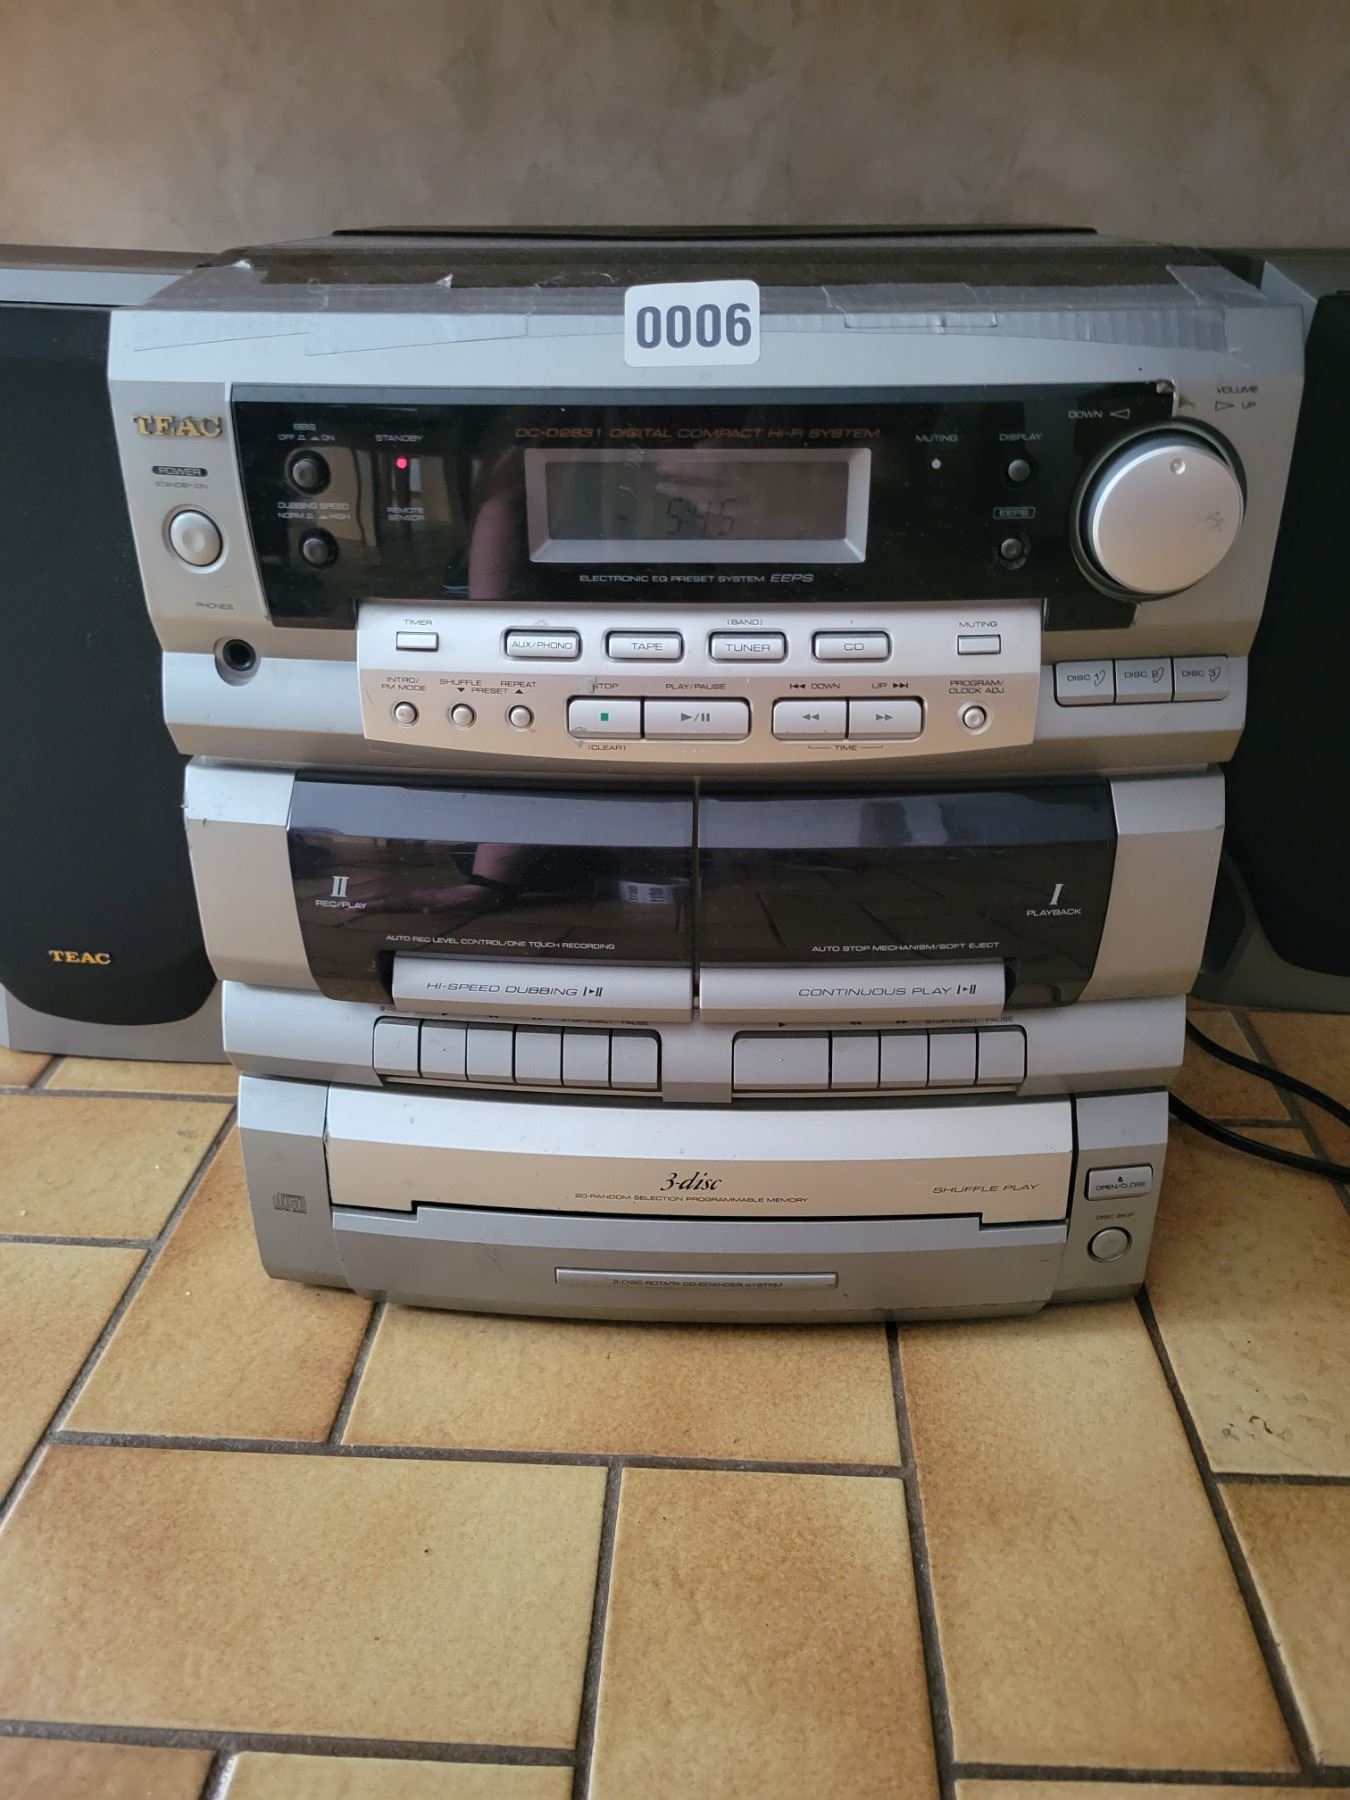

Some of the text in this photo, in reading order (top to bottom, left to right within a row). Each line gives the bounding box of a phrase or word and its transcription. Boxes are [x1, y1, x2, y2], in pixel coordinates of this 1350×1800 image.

[636, 303, 752, 349] 0006
[1216, 385, 1259, 394] VOLUME
[1241, 401, 1257, 410] UP
[1068, 410, 1103, 419] DOWN
[133, 416, 223, 438] TEAC
[609, 427, 673, 438] DIGITAL
[678, 428, 762, 439] COMPACT
[808, 428, 881, 439] SYSTEM
[999, 432, 1043, 442] DISPLAY
[375, 434, 425, 442] STANDBY
[915, 433, 959, 443] MUTING
[158, 466, 201, 477] POWER
[277, 502, 350, 510] DUBBING SPEED
[386, 507, 425, 515] REMOTE
[387, 514, 425, 522] SENSOR
[579, 573, 814, 583] ELECTRONIC EQ PRESET SYSTEM EEPS
[196, 601, 234, 611] PHONES
[404, 618, 433, 626] TIMER
[958, 620, 998, 628] MUTING
[511, 641, 573, 651] AUX/PHONO
[631, 642, 664, 651] TAPE
[726, 643, 771, 652] TUNER
[843, 642, 865, 651] CD
[1066, 673, 1092, 682] DISC
[1123, 670, 1149, 679] DISC
[1181, 669, 1206, 678] DISC
[386, 676, 420, 684] INTRO/
[439, 678, 483, 687] SHUFFLE
[500, 680, 537, 688] REPEAT
[949, 679, 1005, 688] PROGRAM/
[380, 683, 428, 692] FM MODE
[592, 682, 619, 690] TOP
[665, 683, 728, 691] PLAY/PAUSE
[810, 682, 841, 690] DOWN
[871, 682, 888, 690] UP
[948, 686, 1005, 695] CLOCK ADJ
[470, 687, 509, 695] PRESET
[834, 743, 858, 752] TIME
[314, 899, 368, 910] REC/PLAY
[1026, 907, 1082, 918] PLAYBACK
[386, 935, 616, 951] AUTO REC LEVEL CONTROL/ONE TOUCH RECORDING
[811, 941, 1000, 953] AUTO STOP MECHANISM/SOFT EJECT
[49, 950, 112, 966] TEAC
[426, 981, 500, 993] HI-SPEED
[505, 985, 578, 997] DUBBING
[798, 987, 907, 998] CONTINUOUS
[911, 986, 953, 996] PLAY
[660, 1171, 723, 1192] 3-disc
[932, 1183, 1040, 1195] SHUFFLE PLAY
[633, 1194, 684, 1202] SELECTION
